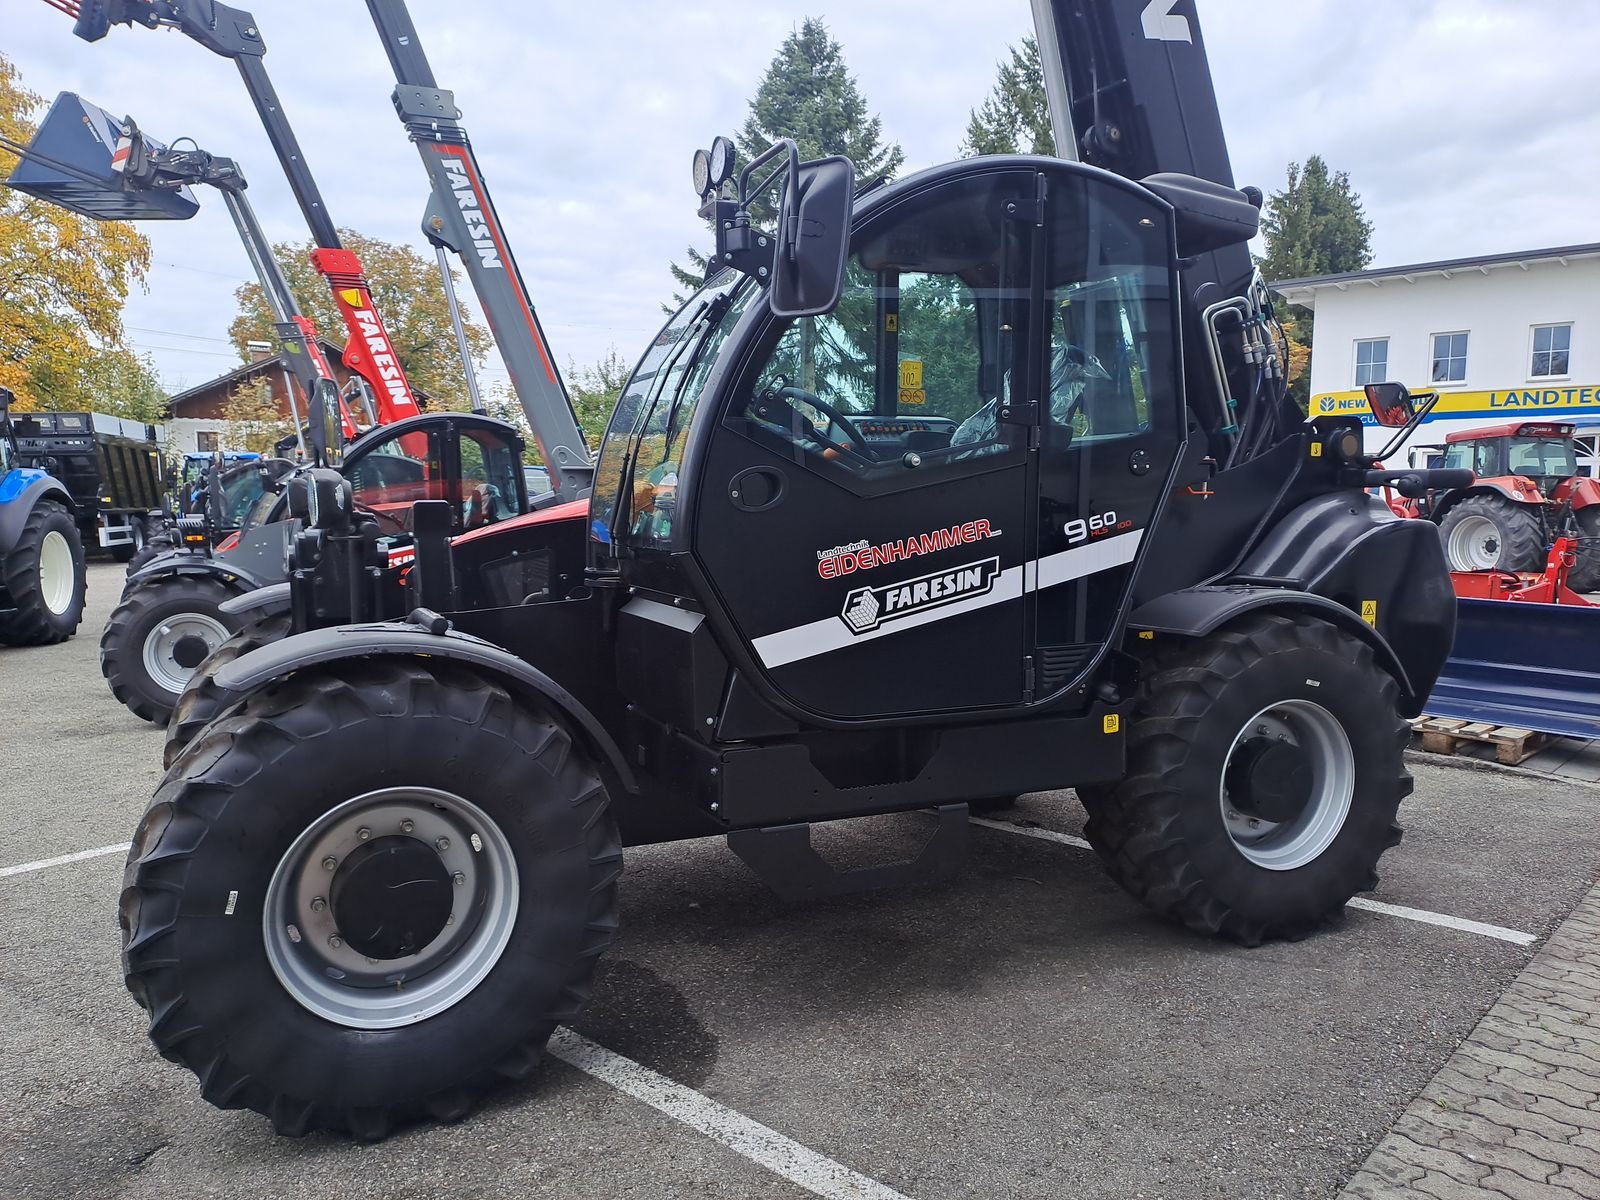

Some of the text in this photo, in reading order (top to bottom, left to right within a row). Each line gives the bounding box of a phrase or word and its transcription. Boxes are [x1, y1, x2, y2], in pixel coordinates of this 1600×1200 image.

[440, 158, 504, 270] FARESIN
[354, 310, 413, 406] FARESIN
[1338, 399, 1366, 409] NEW
[817, 539, 869, 559] Landtechnik
[818, 518, 993, 579] EIDENHAMMER
[1064, 511, 1117, 543] 960
[885, 566, 982, 612] FARESIN
